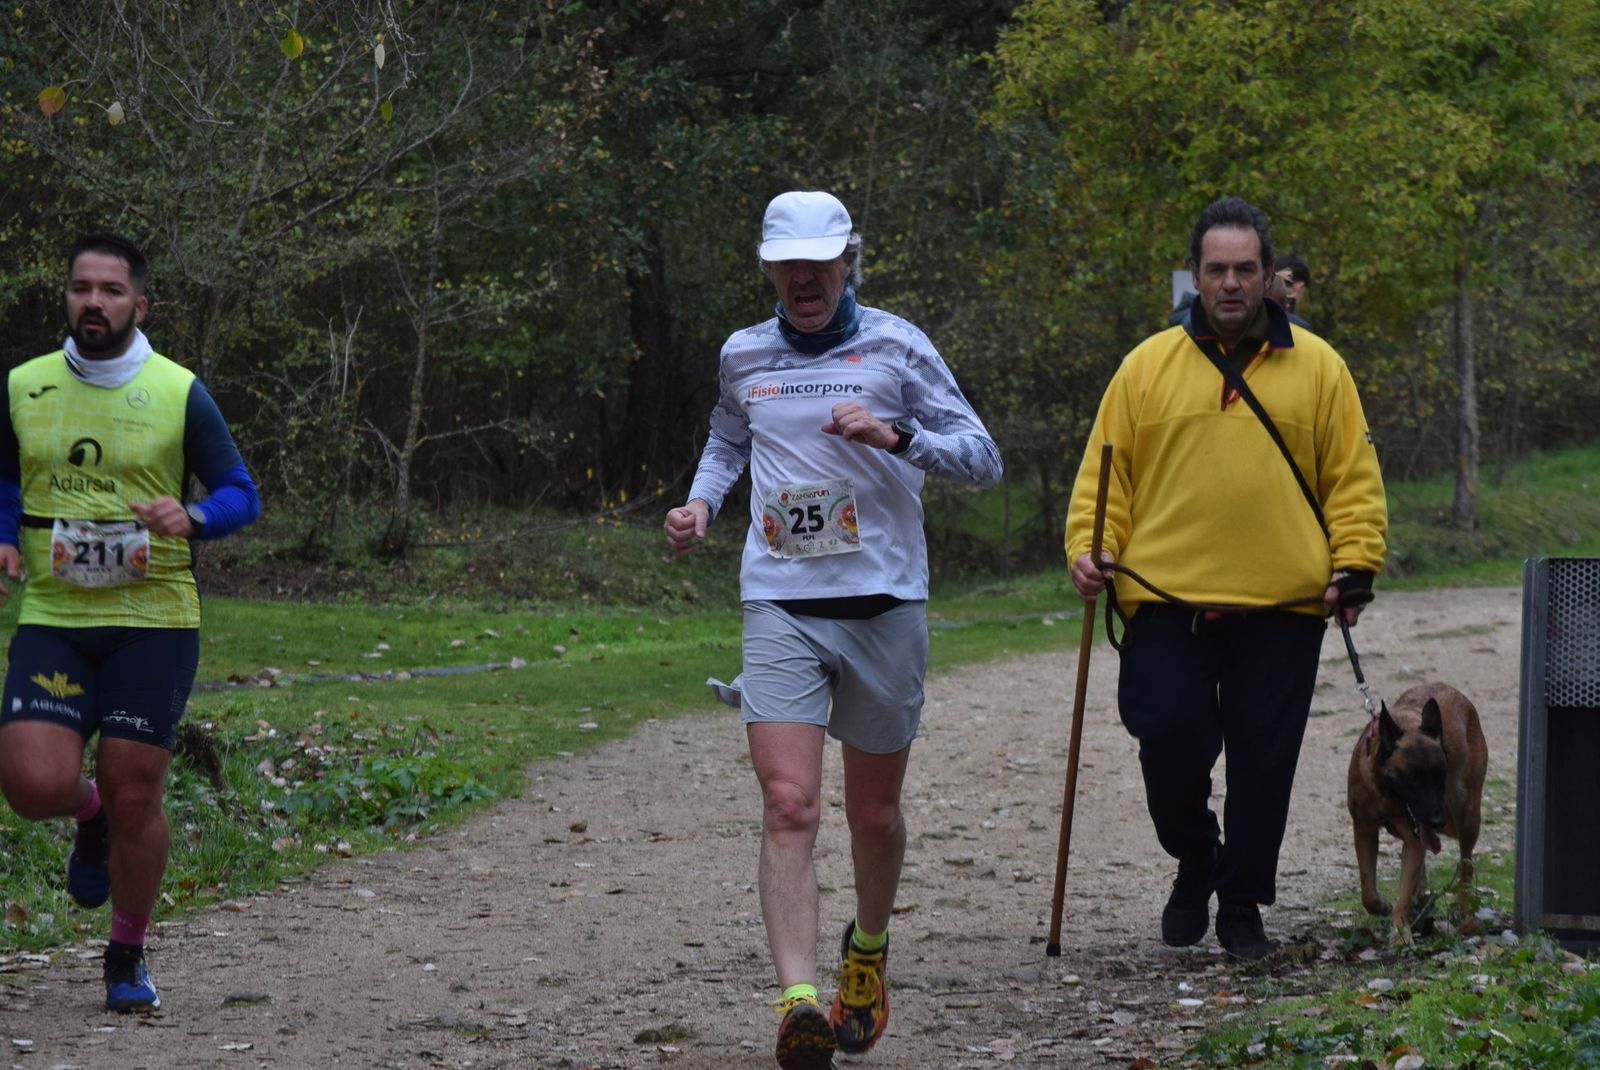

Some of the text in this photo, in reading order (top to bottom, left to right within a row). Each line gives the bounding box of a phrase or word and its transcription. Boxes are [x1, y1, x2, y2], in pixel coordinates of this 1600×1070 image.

[50, 474, 117, 493] Adarsa
[789, 504, 824, 535] 25
[73, 541, 124, 566] 211
